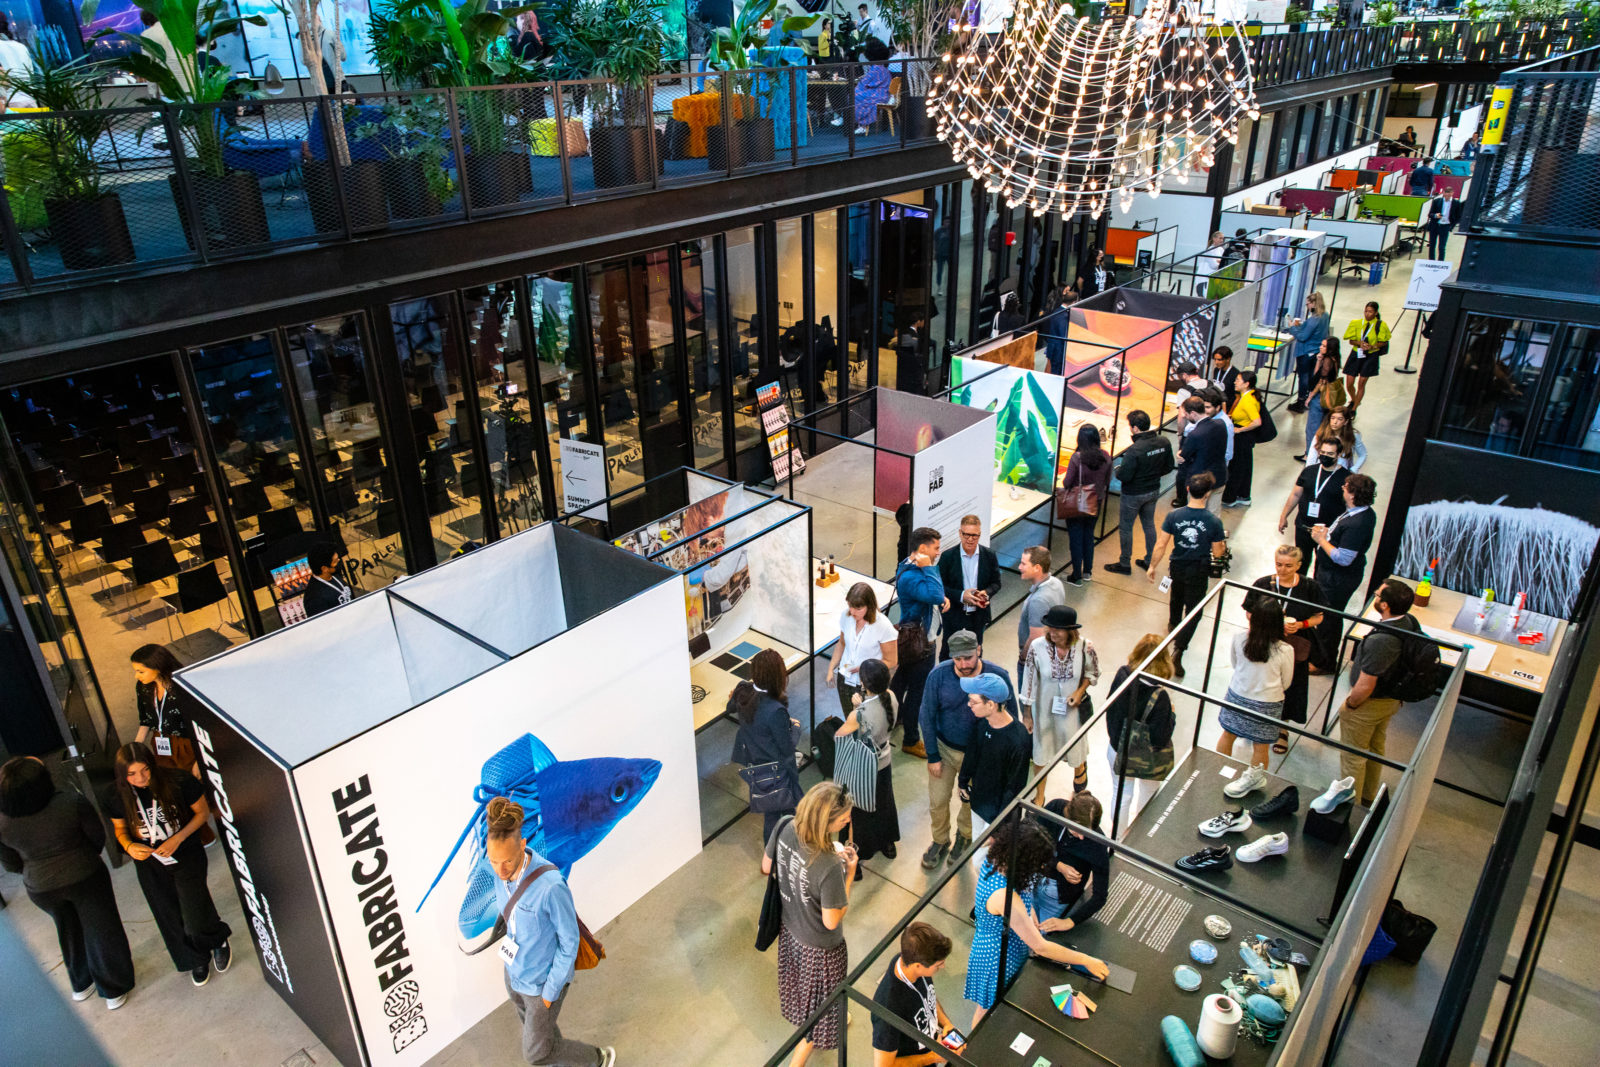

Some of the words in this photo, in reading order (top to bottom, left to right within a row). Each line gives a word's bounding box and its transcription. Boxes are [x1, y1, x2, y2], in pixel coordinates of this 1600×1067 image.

[607, 447, 642, 482] PARLEY
[928, 476, 944, 494] FAB
[567, 495, 591, 505] SUMMIT
[346, 542, 397, 586] PARLEY
[1513, 670, 1535, 680] K18
[331, 773, 428, 1055] BIOFABRICATE
[501, 945, 514, 959] FAB
